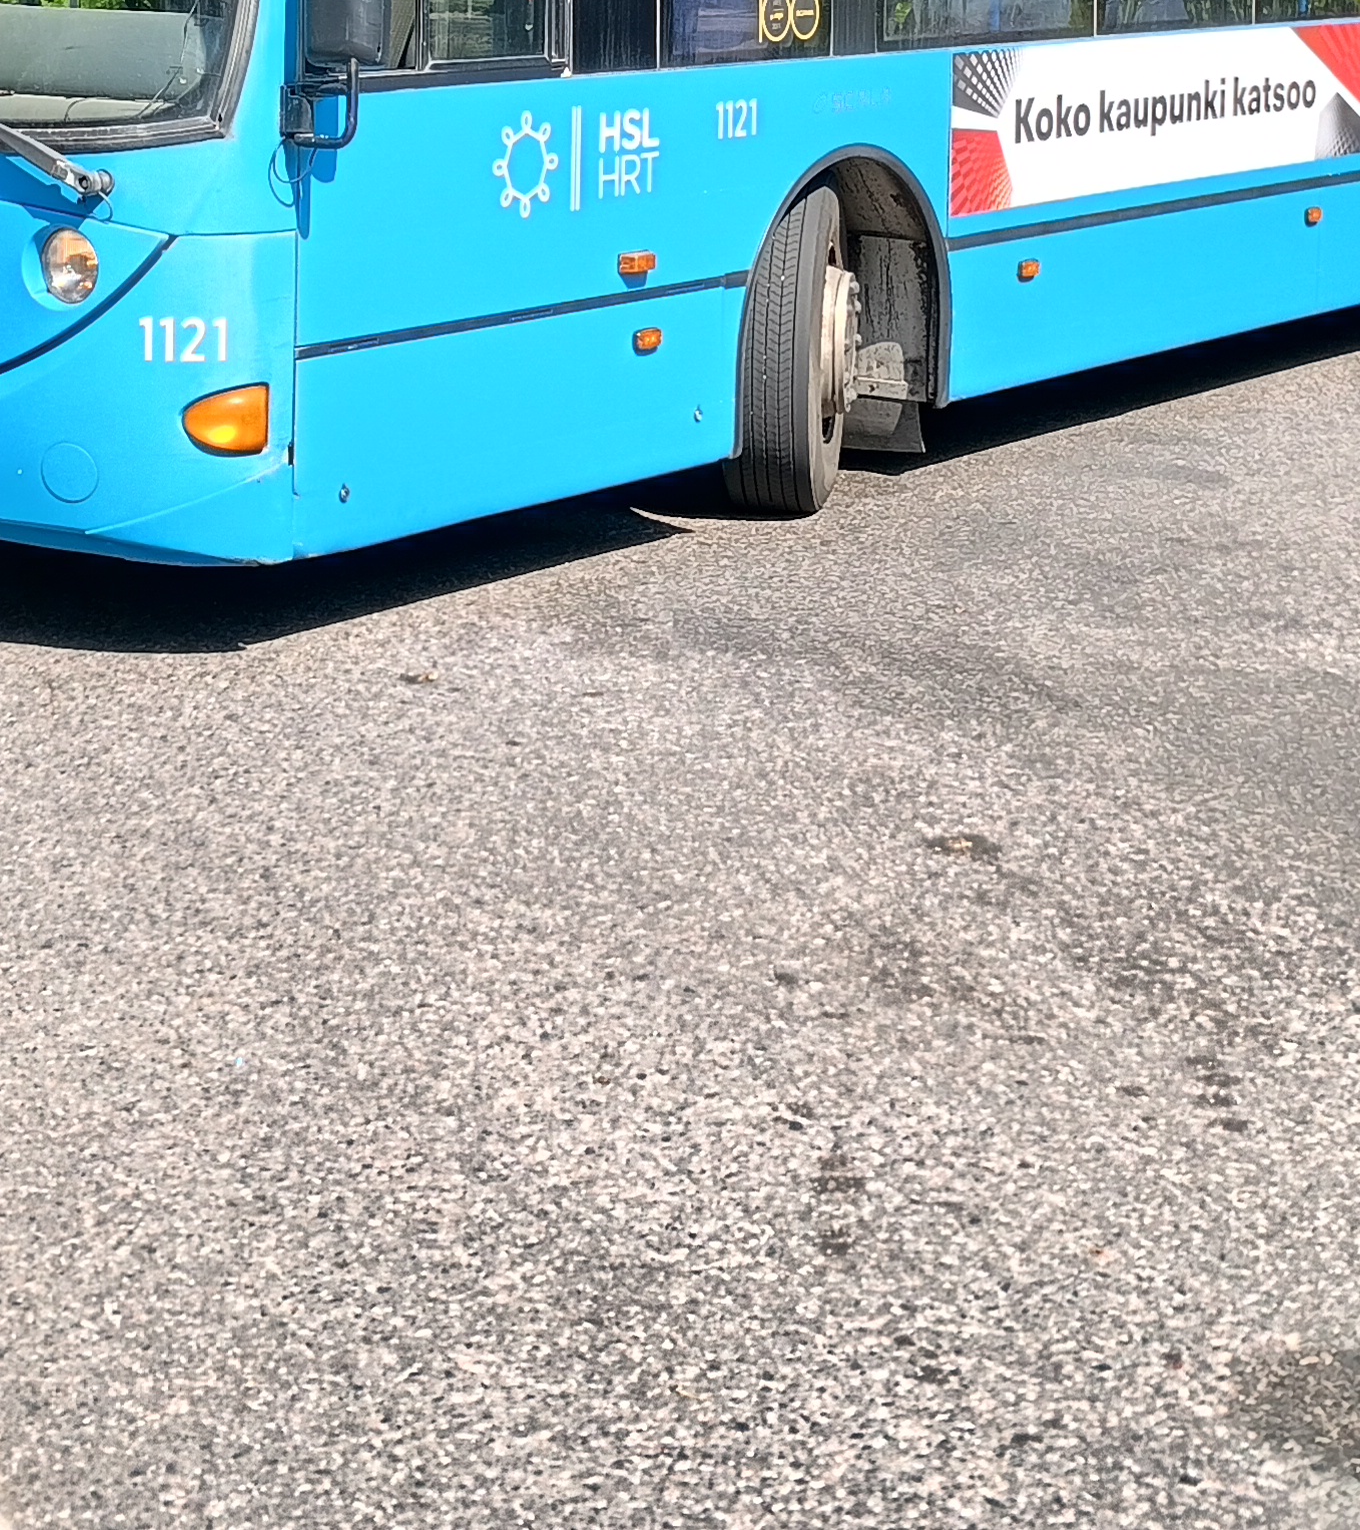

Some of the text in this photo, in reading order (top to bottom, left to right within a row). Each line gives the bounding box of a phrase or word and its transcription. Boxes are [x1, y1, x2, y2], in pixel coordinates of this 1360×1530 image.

[598, 107, 660, 154] HSL
[715, 98, 758, 140] 1121
[1014, 77, 1317, 144] Koko kaupunki katsoo
[598, 150, 660, 200] HRT
[138, 315, 228, 363] 1121
